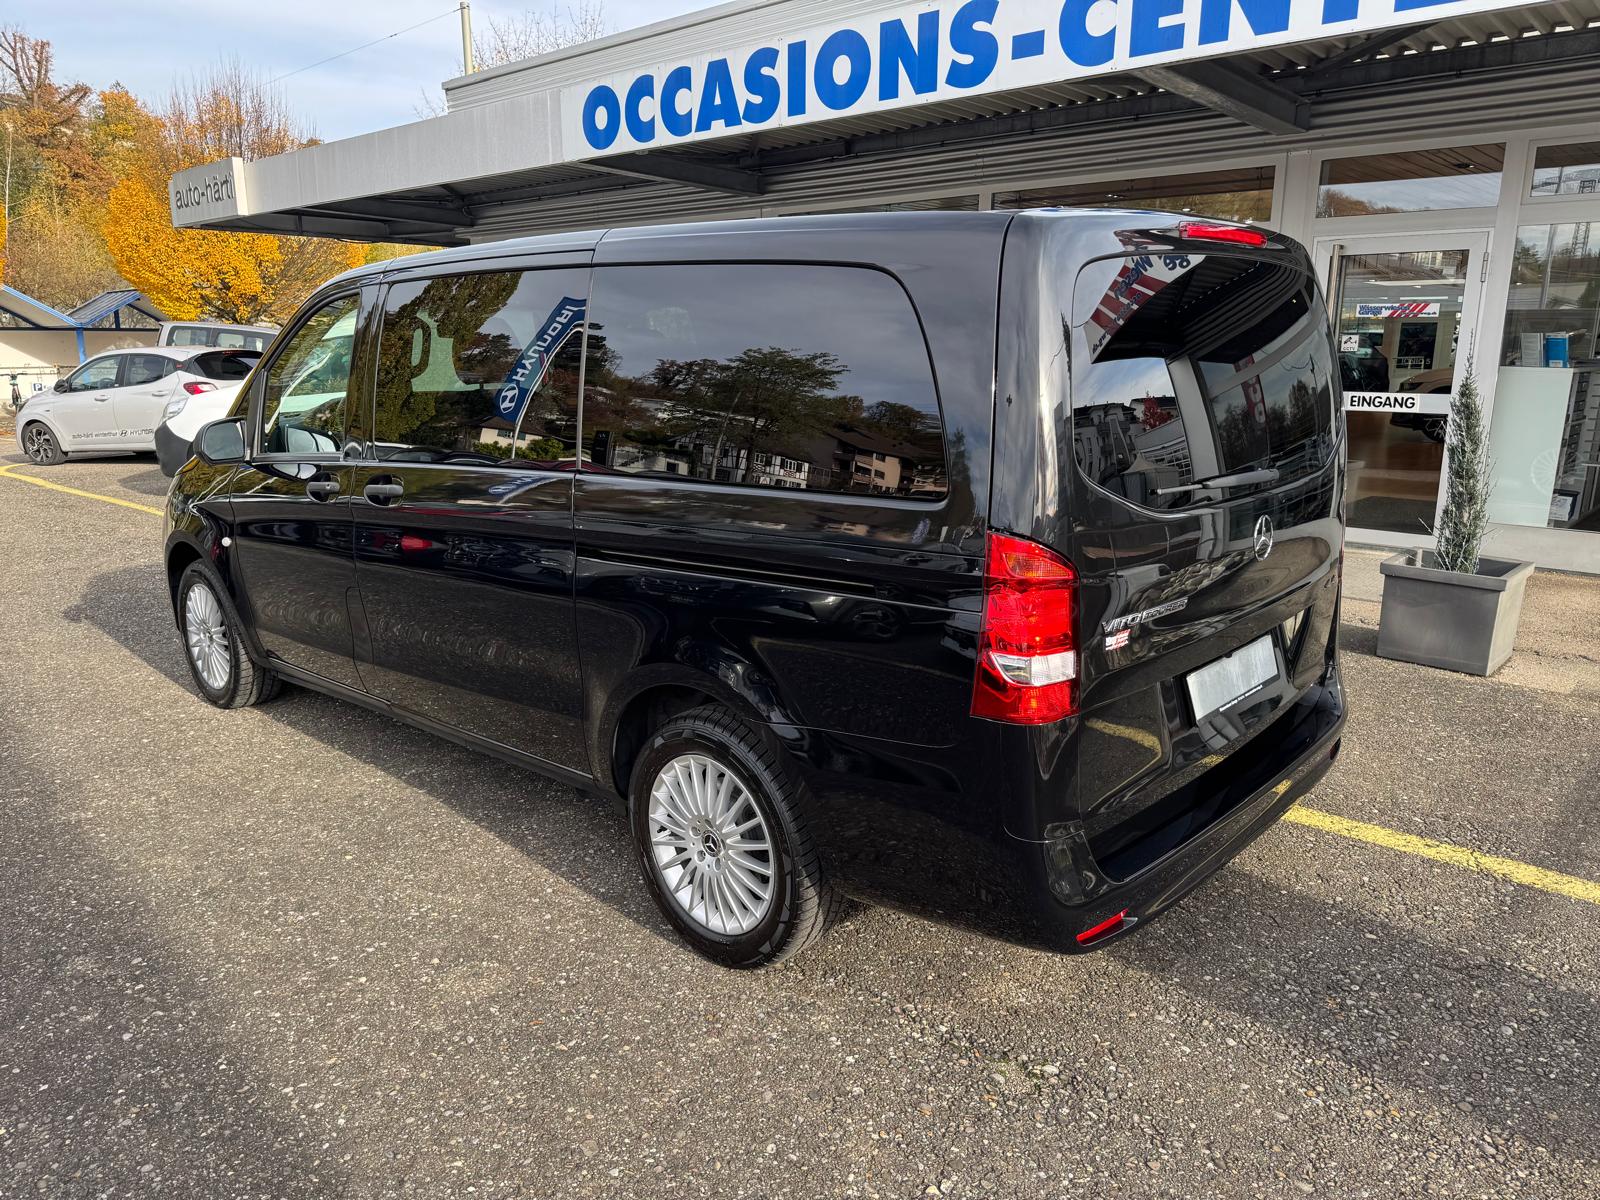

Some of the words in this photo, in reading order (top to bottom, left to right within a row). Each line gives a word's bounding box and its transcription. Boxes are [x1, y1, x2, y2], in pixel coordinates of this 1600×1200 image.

[582, 0, 1460, 150] OCCASIONS-CE
[175, 171, 234, 210] auto-härti
[1350, 395, 1416, 409] EINGANG
[1102, 612, 1141, 634] VITO
